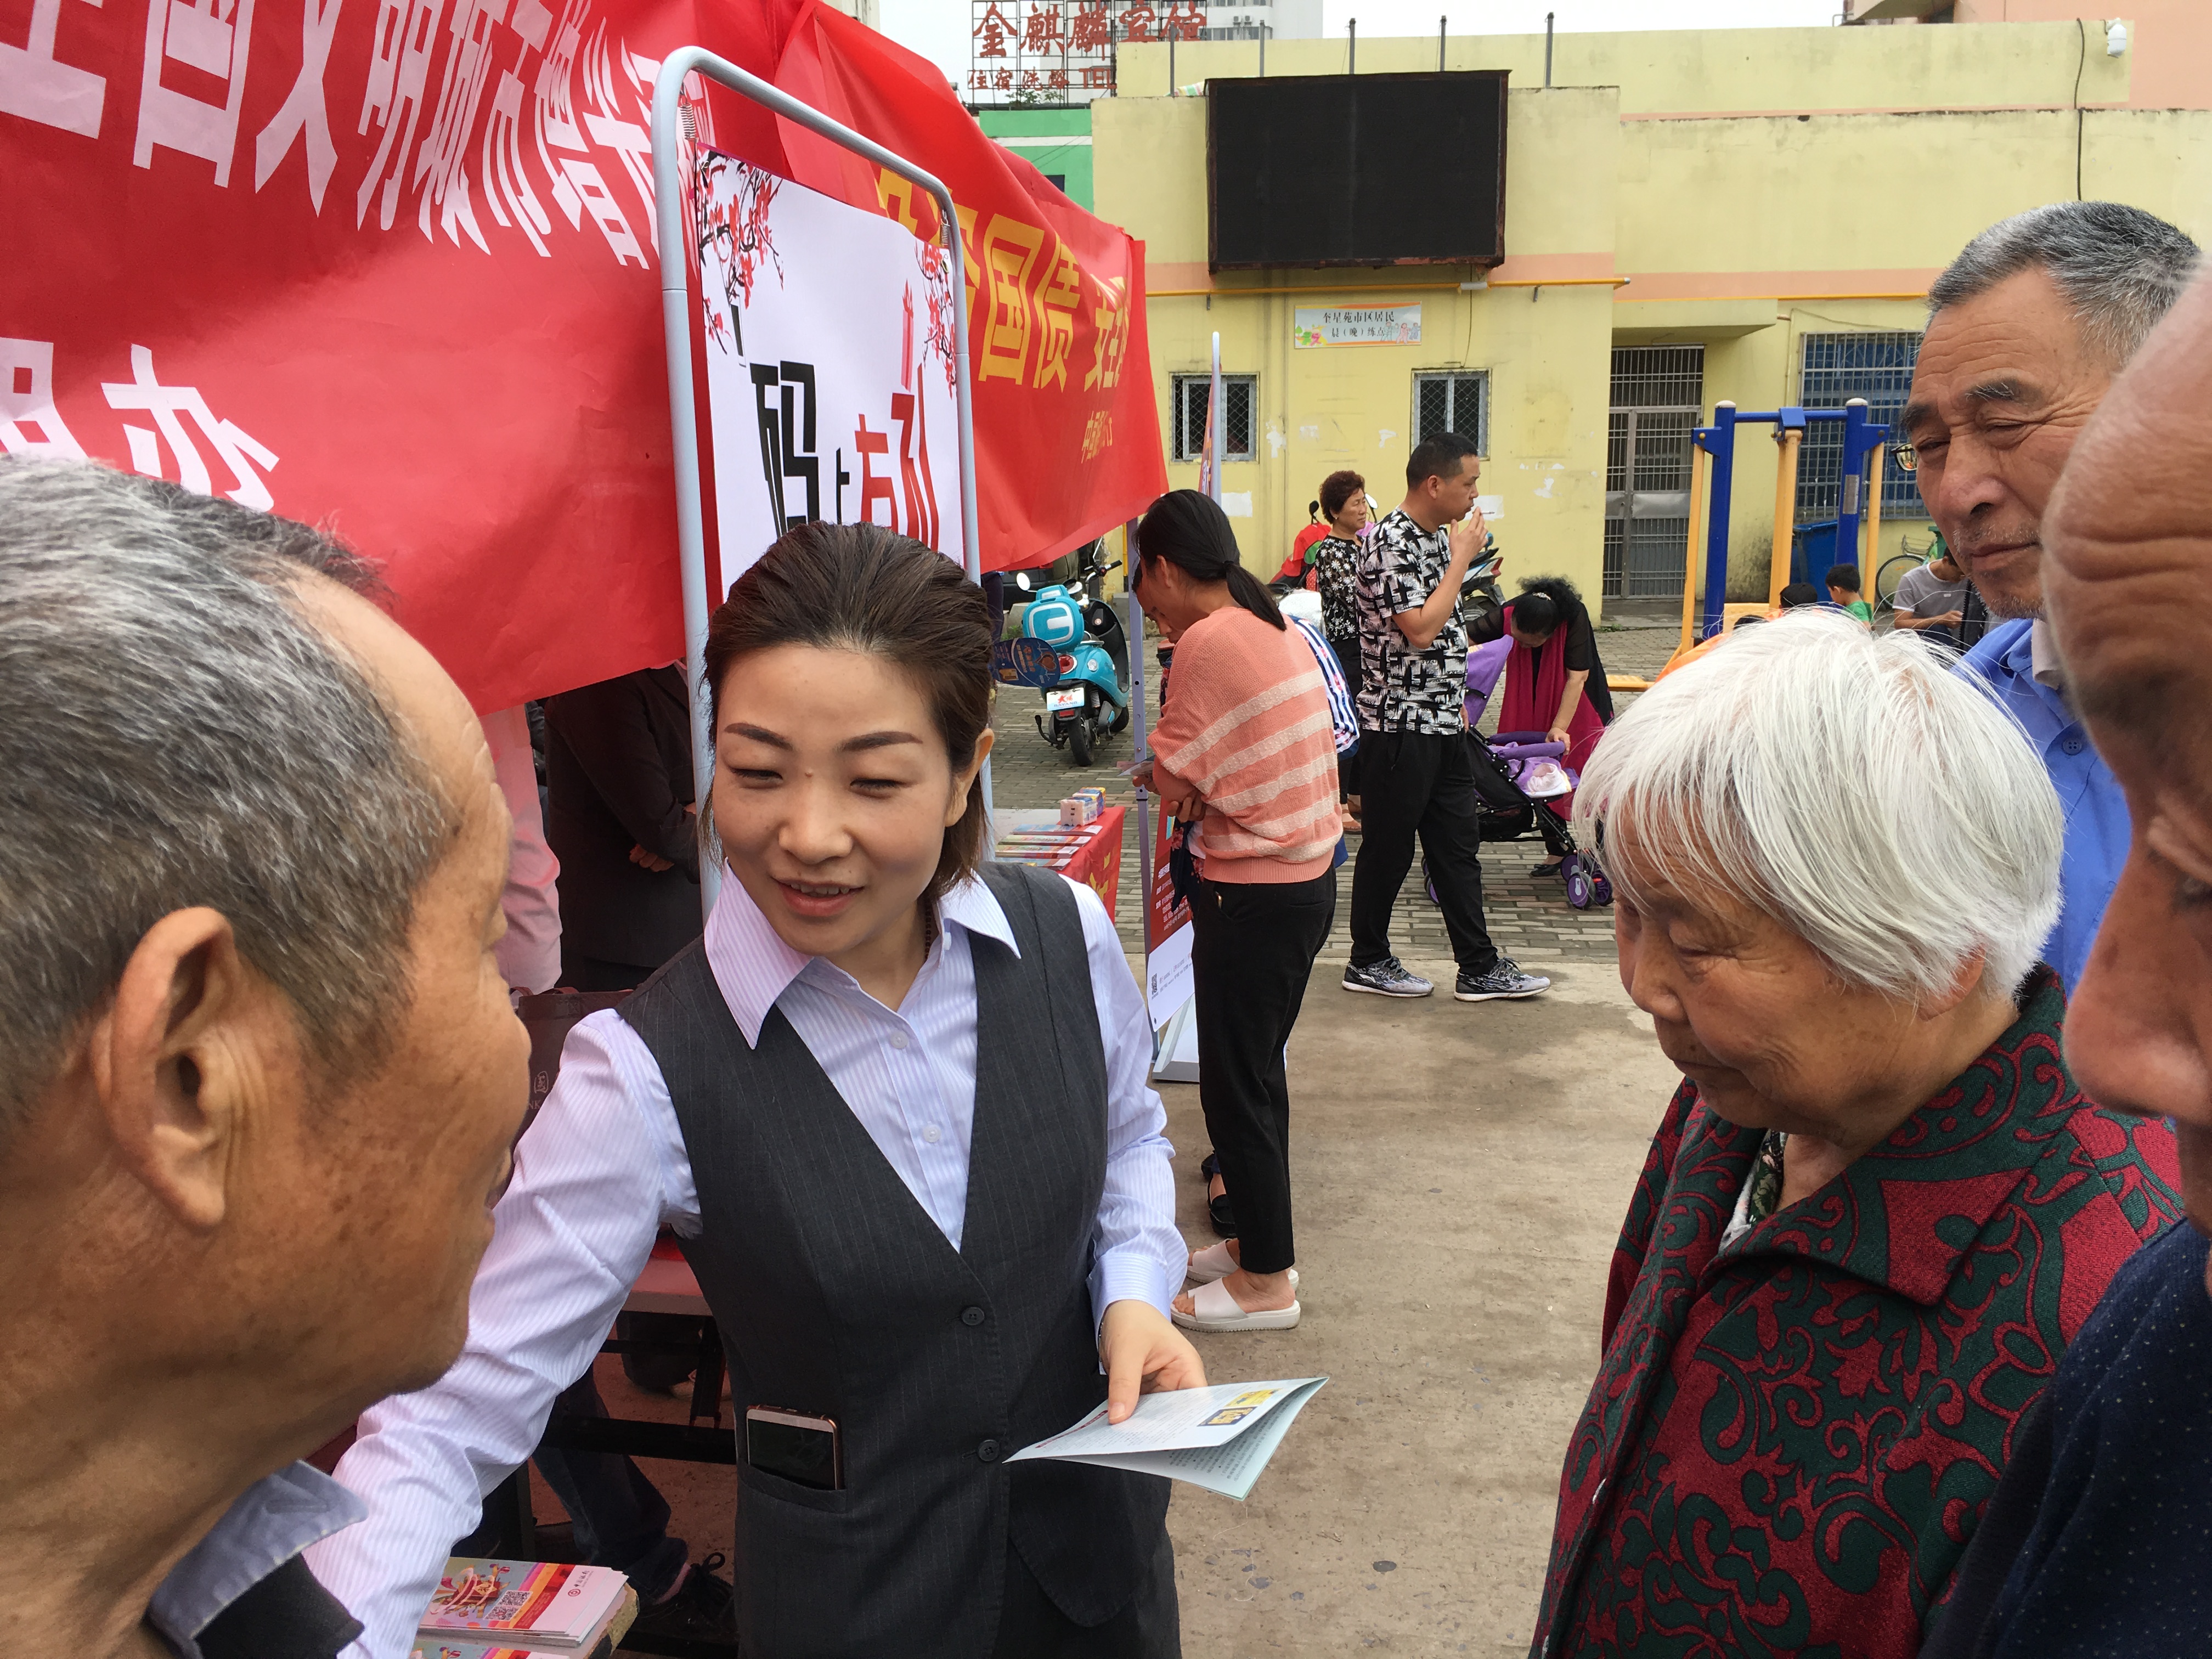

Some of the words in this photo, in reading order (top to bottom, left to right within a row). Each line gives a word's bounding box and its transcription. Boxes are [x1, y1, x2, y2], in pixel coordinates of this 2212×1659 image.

[972, 0, 1207, 61] 金麒麟宾馆
[1079, 67, 1117, 89] TEL
